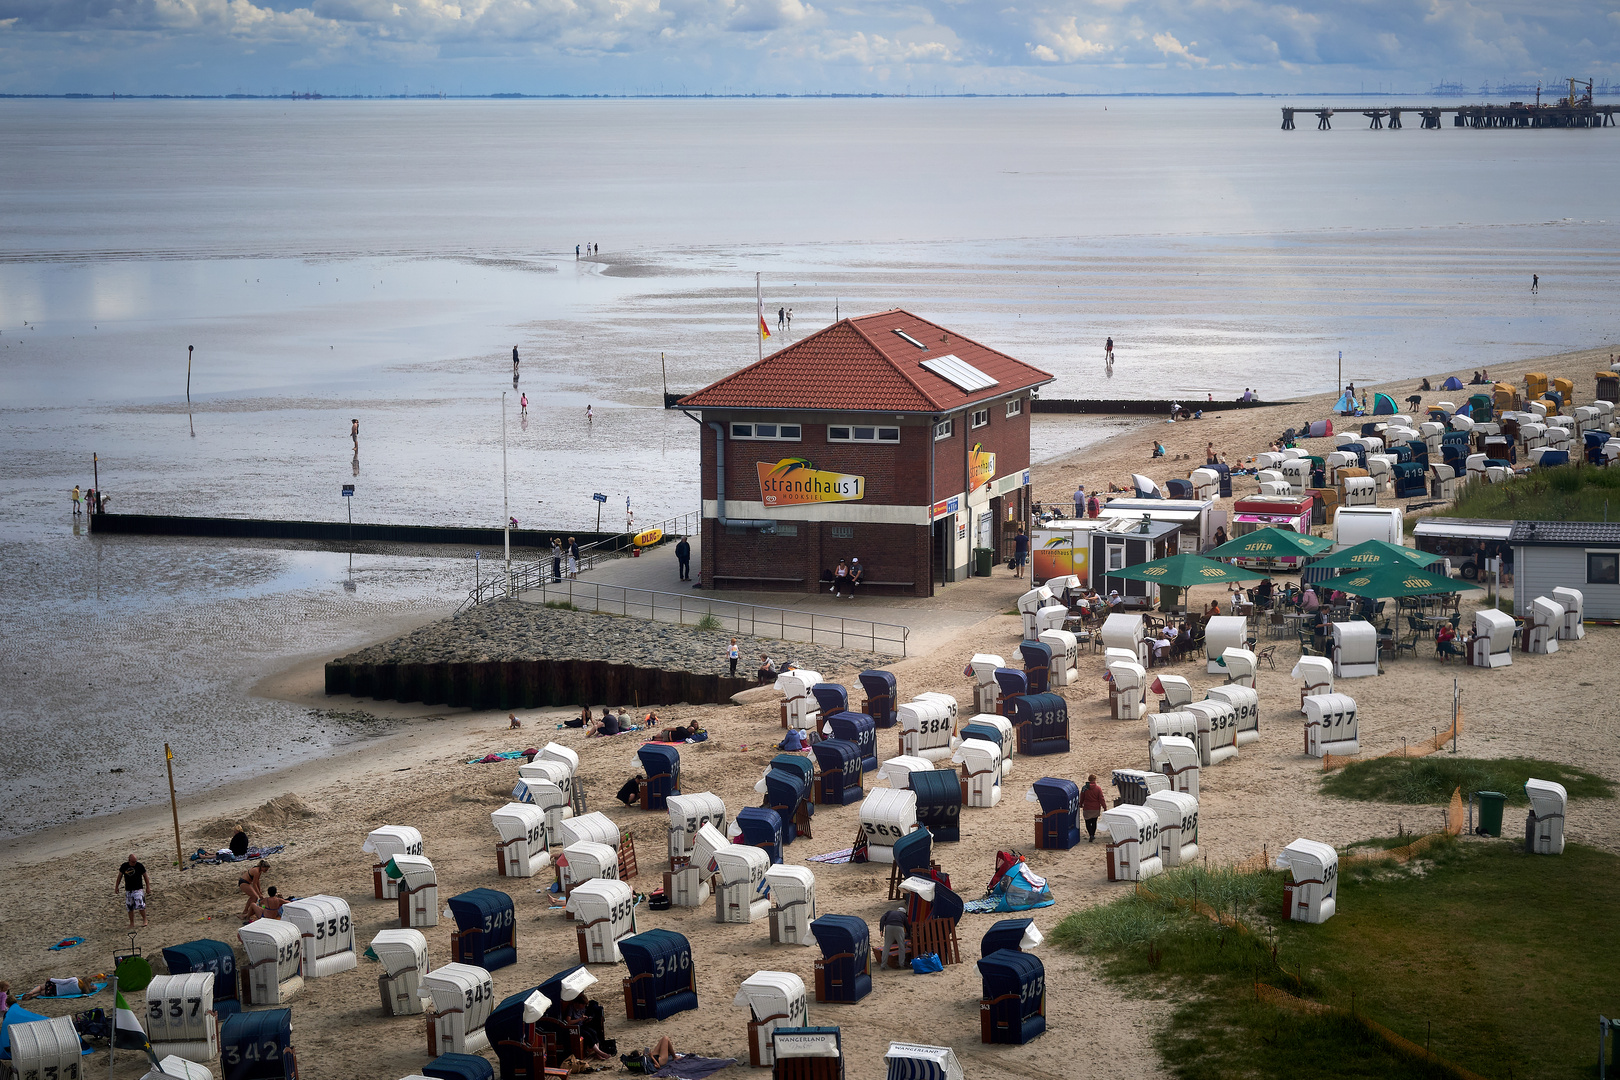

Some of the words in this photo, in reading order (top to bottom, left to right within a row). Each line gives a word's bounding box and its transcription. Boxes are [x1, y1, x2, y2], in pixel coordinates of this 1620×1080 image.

[1357, 450, 1366, 459] 36
[1282, 468, 1300, 477] 424
[1404, 467, 1424, 479] 419
[764, 477, 850, 494] strandhaus
[853, 478, 859, 495] 1
[1352, 487, 1374, 497] 417
[782, 493, 823, 501] HOOKSIEL
[641, 531, 657, 544] DLRG
[1244, 542, 1273, 552] JEVER
[1350, 554, 1380, 563] JEVER
[1402, 578, 1433, 588] JEVER
[920, 717, 950, 734] 384
[1033, 709, 1066, 726] 388
[1210, 712, 1235, 731] 392
[1322, 711, 1355, 728] 377
[857, 727, 875, 746] 381
[842, 756, 861, 776] 380
[557, 777, 571, 793] 82
[918, 805, 959, 818] 370
[862, 822, 902, 838] 369
[1181, 811, 1198, 835] 365
[527, 821, 545, 846] 363
[1139, 822, 1159, 845] 366
[602, 863, 617, 880] 360
[1322, 862, 1338, 885] 350
[611, 898, 632, 925] 355
[315, 914, 350, 940] 338
[484, 908, 513, 934] 348
[278, 939, 301, 965] 352
[655, 950, 689, 978] 346
[464, 980, 492, 1009] 345
[1020, 976, 1044, 1004] 343
[148, 997, 202, 1020] 337
[789, 994, 805, 1022] 339
[225, 1040, 279, 1066] 342
